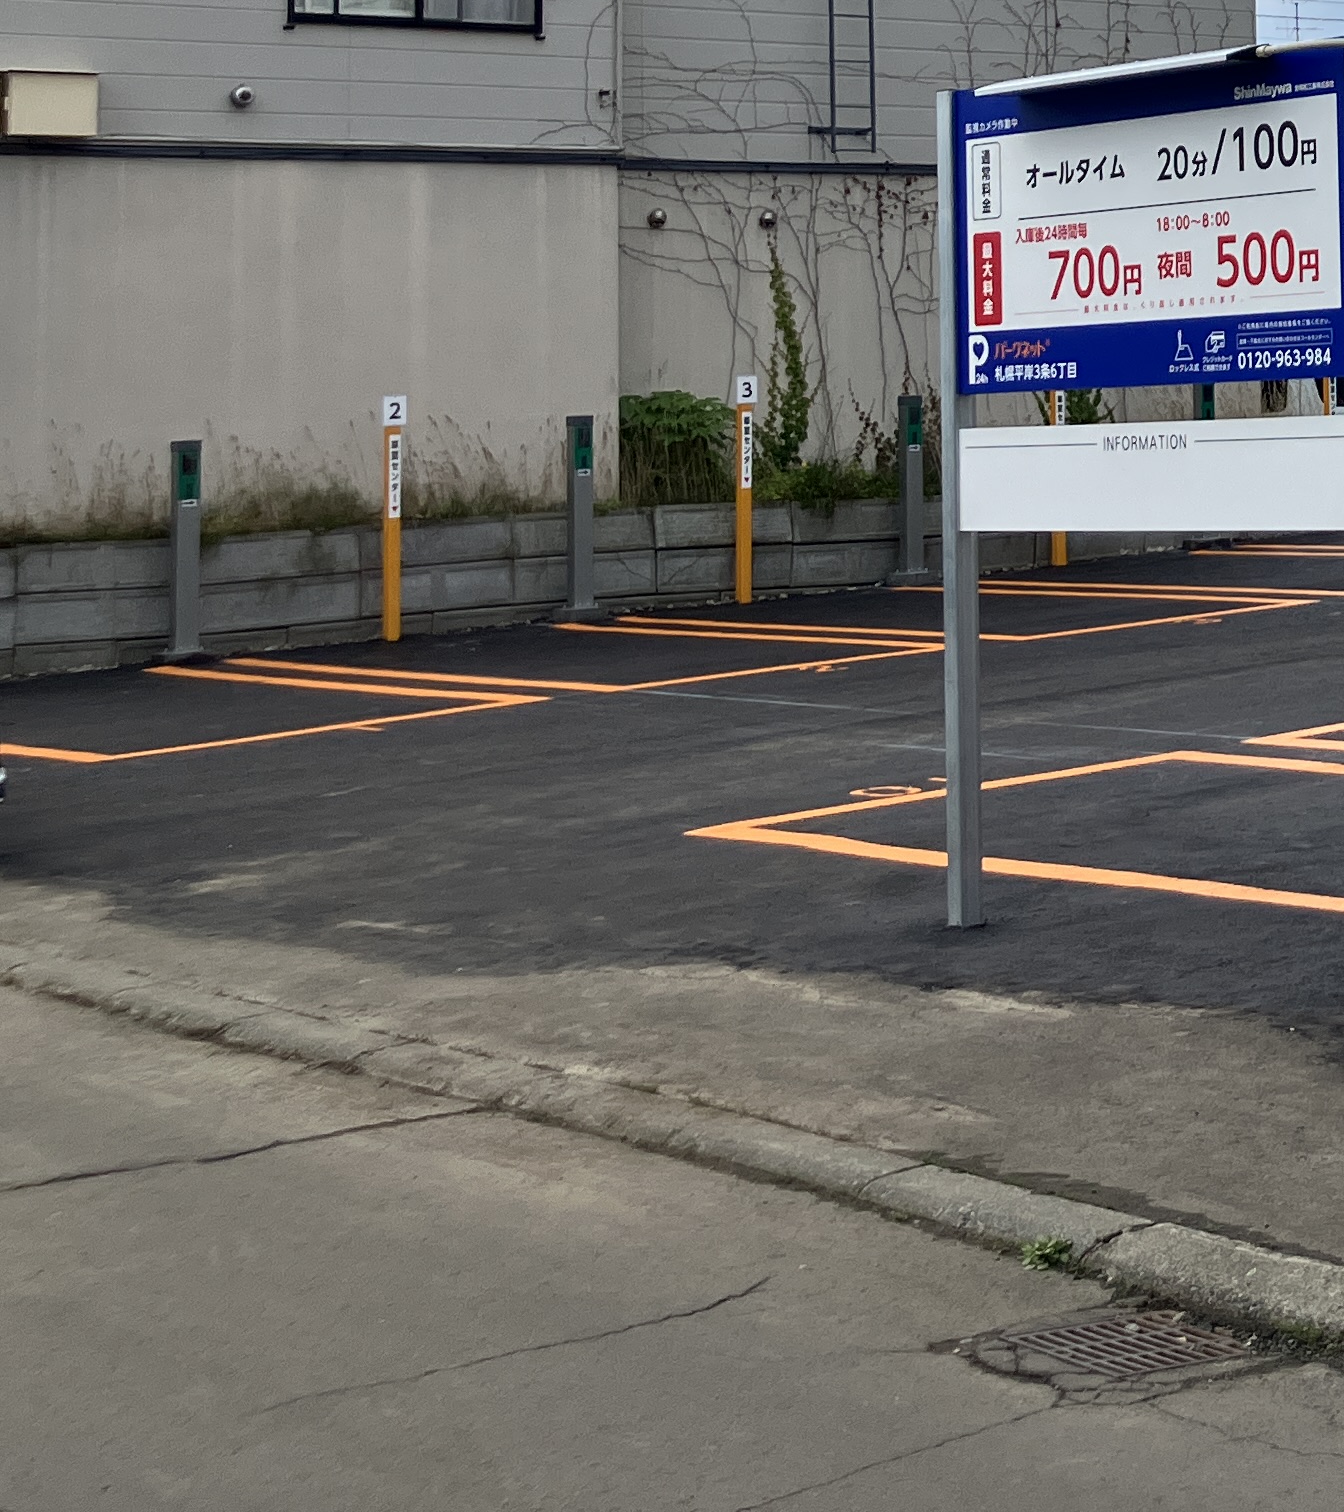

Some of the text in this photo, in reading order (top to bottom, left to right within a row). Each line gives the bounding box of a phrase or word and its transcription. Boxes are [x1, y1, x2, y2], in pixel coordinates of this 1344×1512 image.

[1233, 83, 1293, 101] ShinMaywa
[1026, 120, 1317, 189] オールタイム 20分/100円
[981, 149, 991, 214] 通常料金
[1015, 222, 1088, 245] 入庫後24時間毎
[1157, 229, 1320, 287] 夜間 500円
[982, 242, 993, 316] 最大料金
[1048, 245, 1142, 300] 700円
[1238, 347, 1331, 369] 0120-963-984
[995, 362, 1077, 382] 札幌平岸3条6丁目
[741, 381, 753, 398] 3
[389, 402, 401, 420] 2
[1102, 434, 1188, 452] INFORMATION
